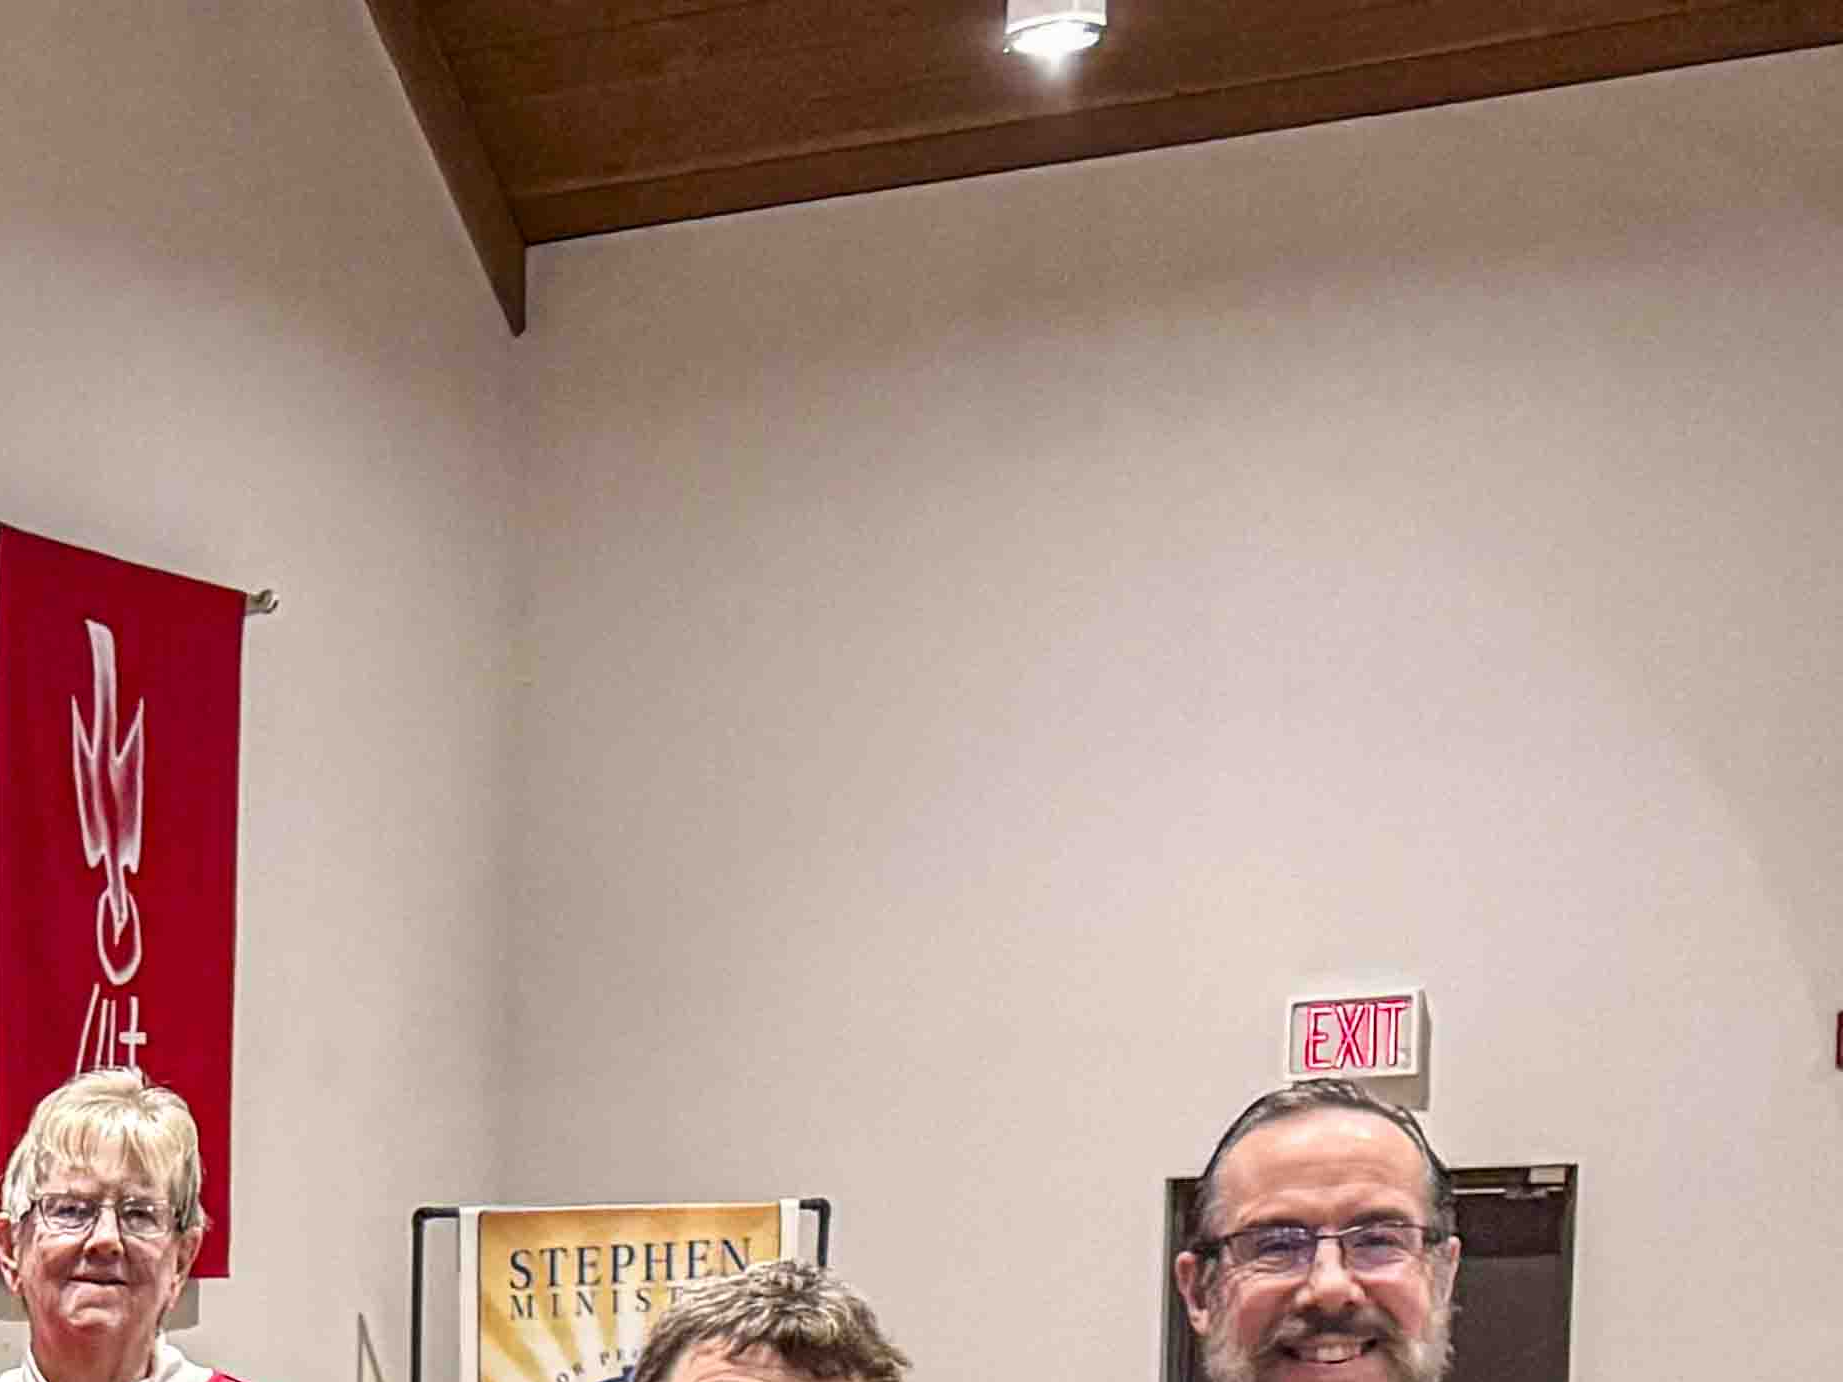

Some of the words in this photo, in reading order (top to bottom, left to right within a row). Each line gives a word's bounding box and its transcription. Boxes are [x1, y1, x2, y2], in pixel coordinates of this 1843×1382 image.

[1303, 1000, 1412, 1072] EXIT
[509, 1236, 752, 1291] STEPHEN
[509, 1286, 684, 1321] MINIST
